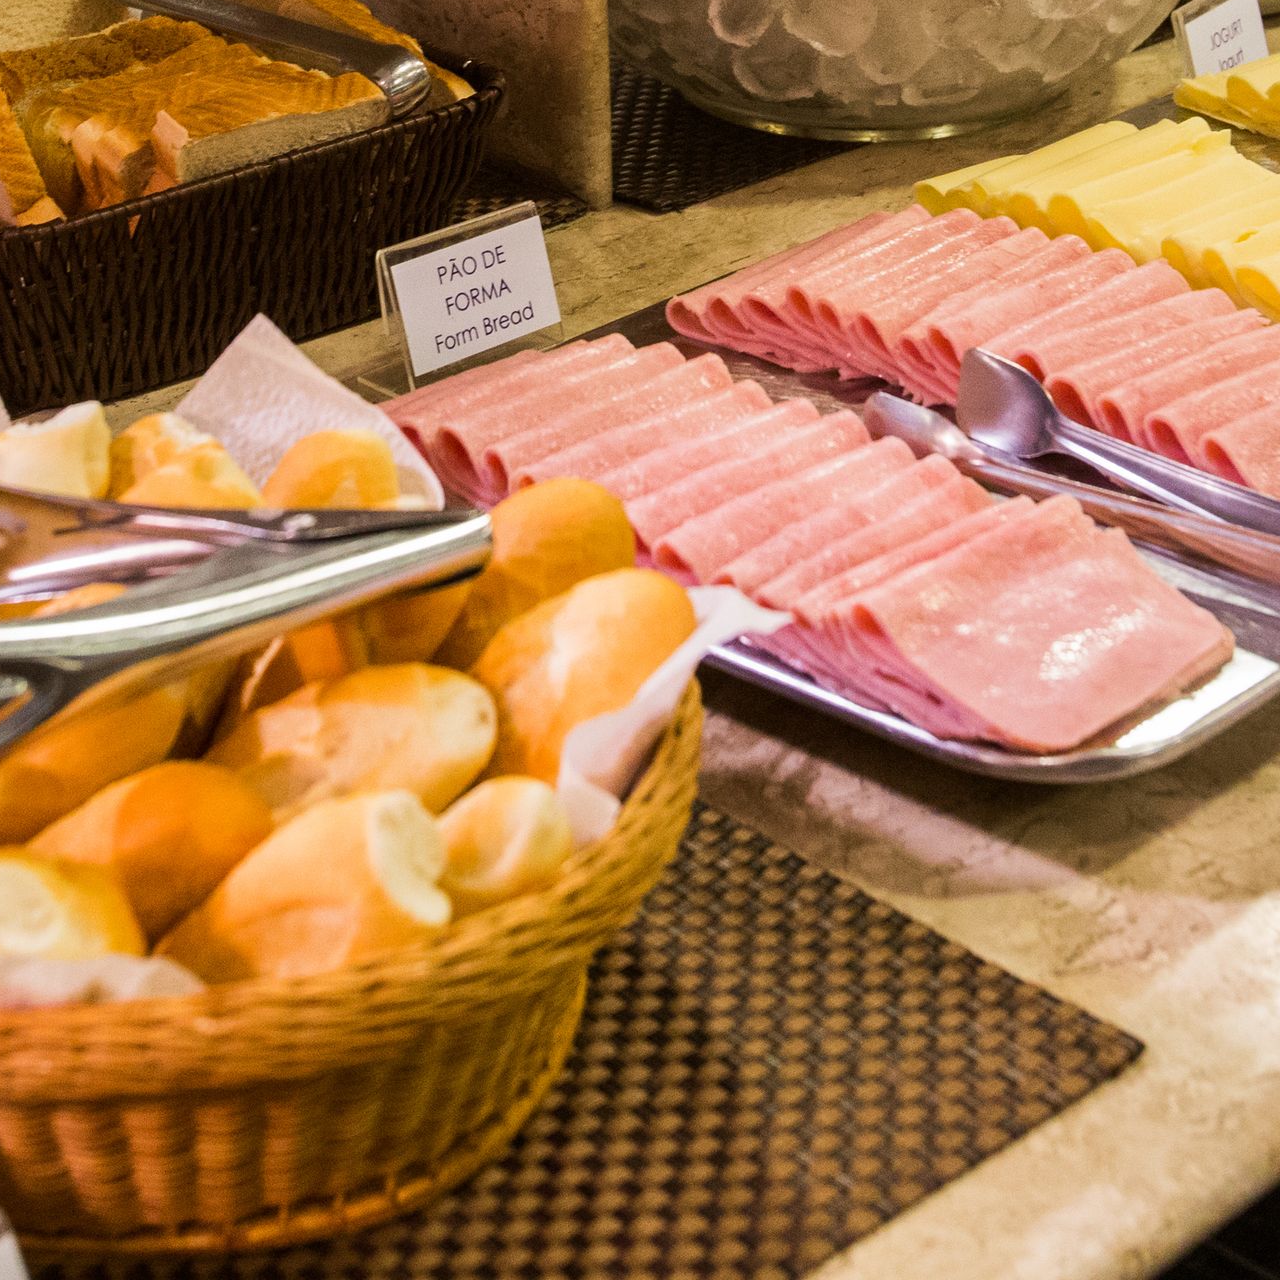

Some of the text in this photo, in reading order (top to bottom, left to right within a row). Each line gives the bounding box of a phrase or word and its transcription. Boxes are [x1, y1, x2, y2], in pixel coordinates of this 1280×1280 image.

[437, 245, 506, 285] PÃO DE
[445, 278, 512, 316] FORMA
[435, 301, 535, 354] Form Bread
